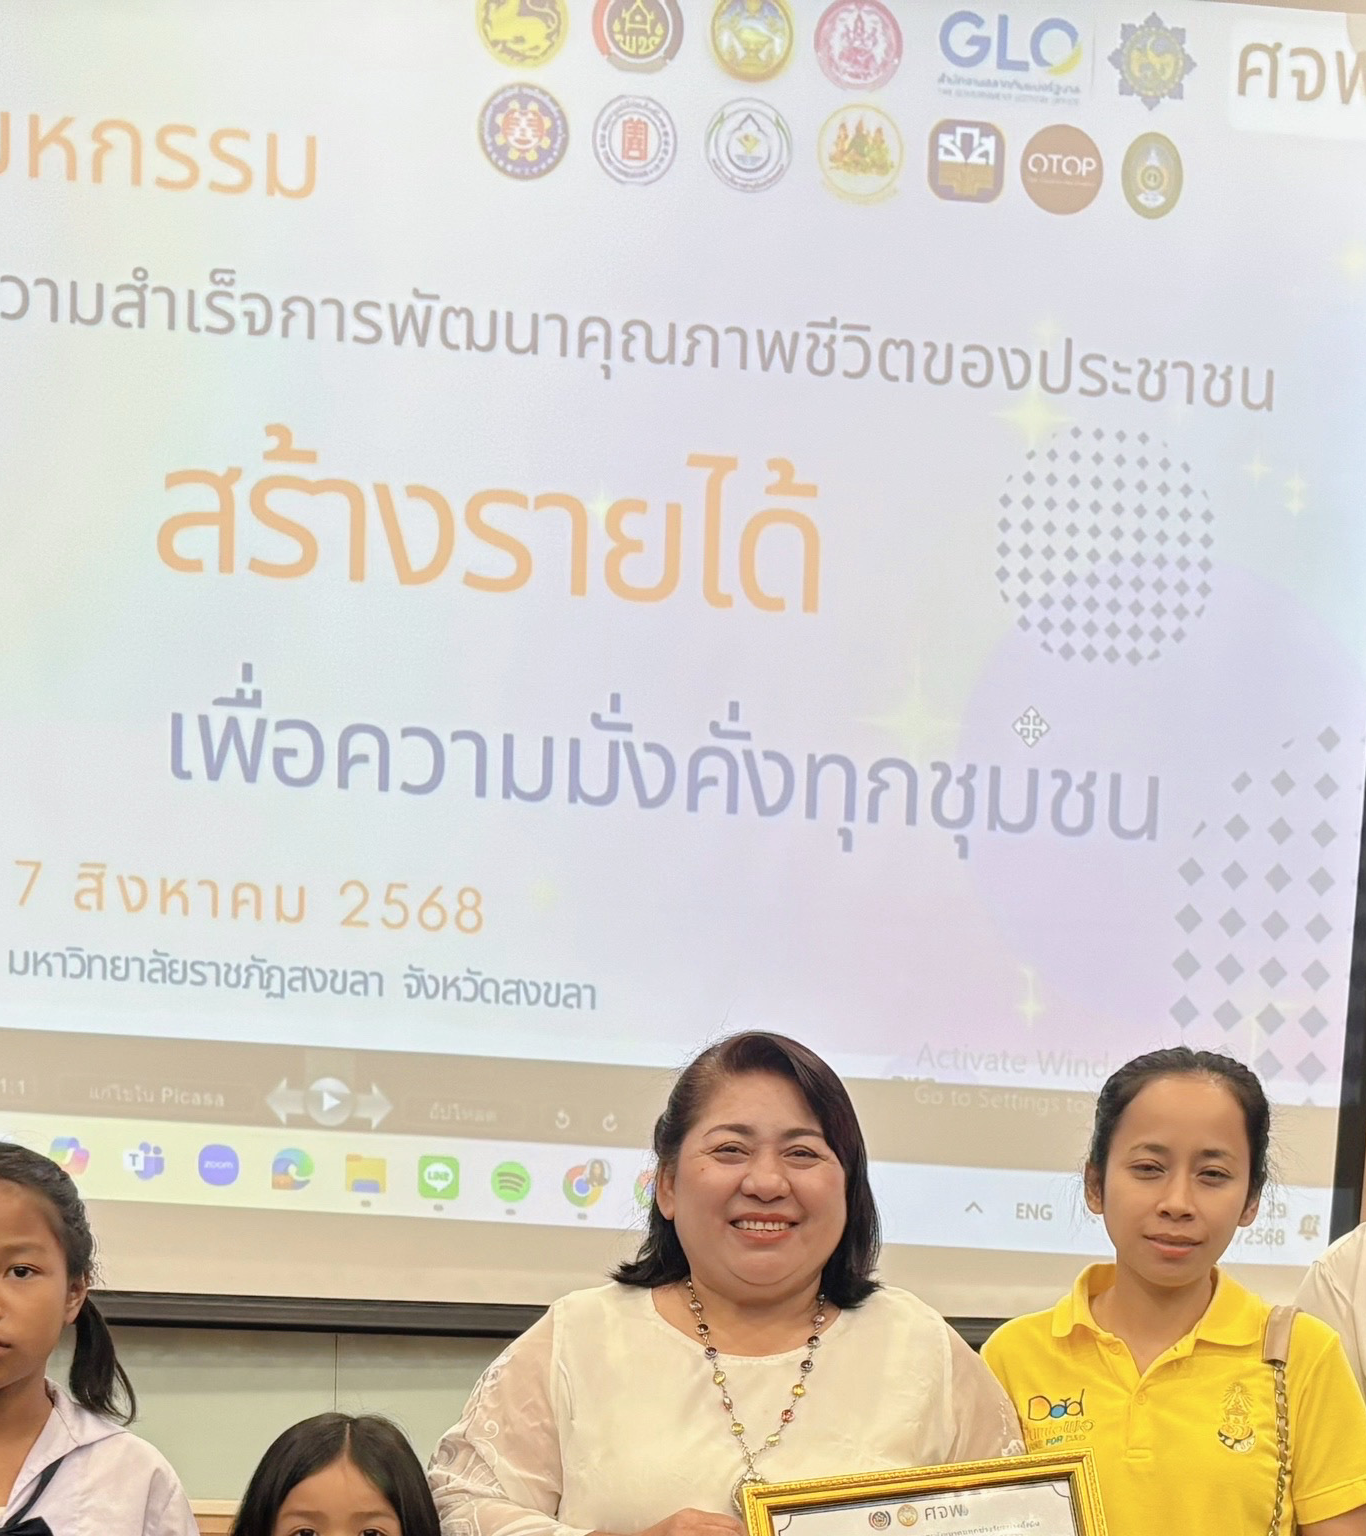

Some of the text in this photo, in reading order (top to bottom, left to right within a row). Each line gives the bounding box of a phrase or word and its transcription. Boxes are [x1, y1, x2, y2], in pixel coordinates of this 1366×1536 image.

[939, 10, 1083, 76] GLO
[1028, 153, 1096, 176] OTOP
[156, 423, 821, 615] สร้างรายได้
[169, 662, 1160, 860] เพื่อความมั่งคั่งทุกชุมชน
[14, 860, 485, 935] 7 สิงหาคม 2568
[8, 946, 384, 1000] มหาวิทยาลัยราชภัฏสงขลา
[402, 964, 597, 1011] จังหวัดสงขลา
[916, 1042, 1027, 1077] Activate
[160, 1086, 226, 1107] Picasa
[914, 1084, 943, 1105] Go
[951, 1091, 970, 1107] to
[979, 1089, 1060, 1116] Settings
[203, 1160, 234, 1170] zoom
[1015, 1202, 1053, 1221] ENG
